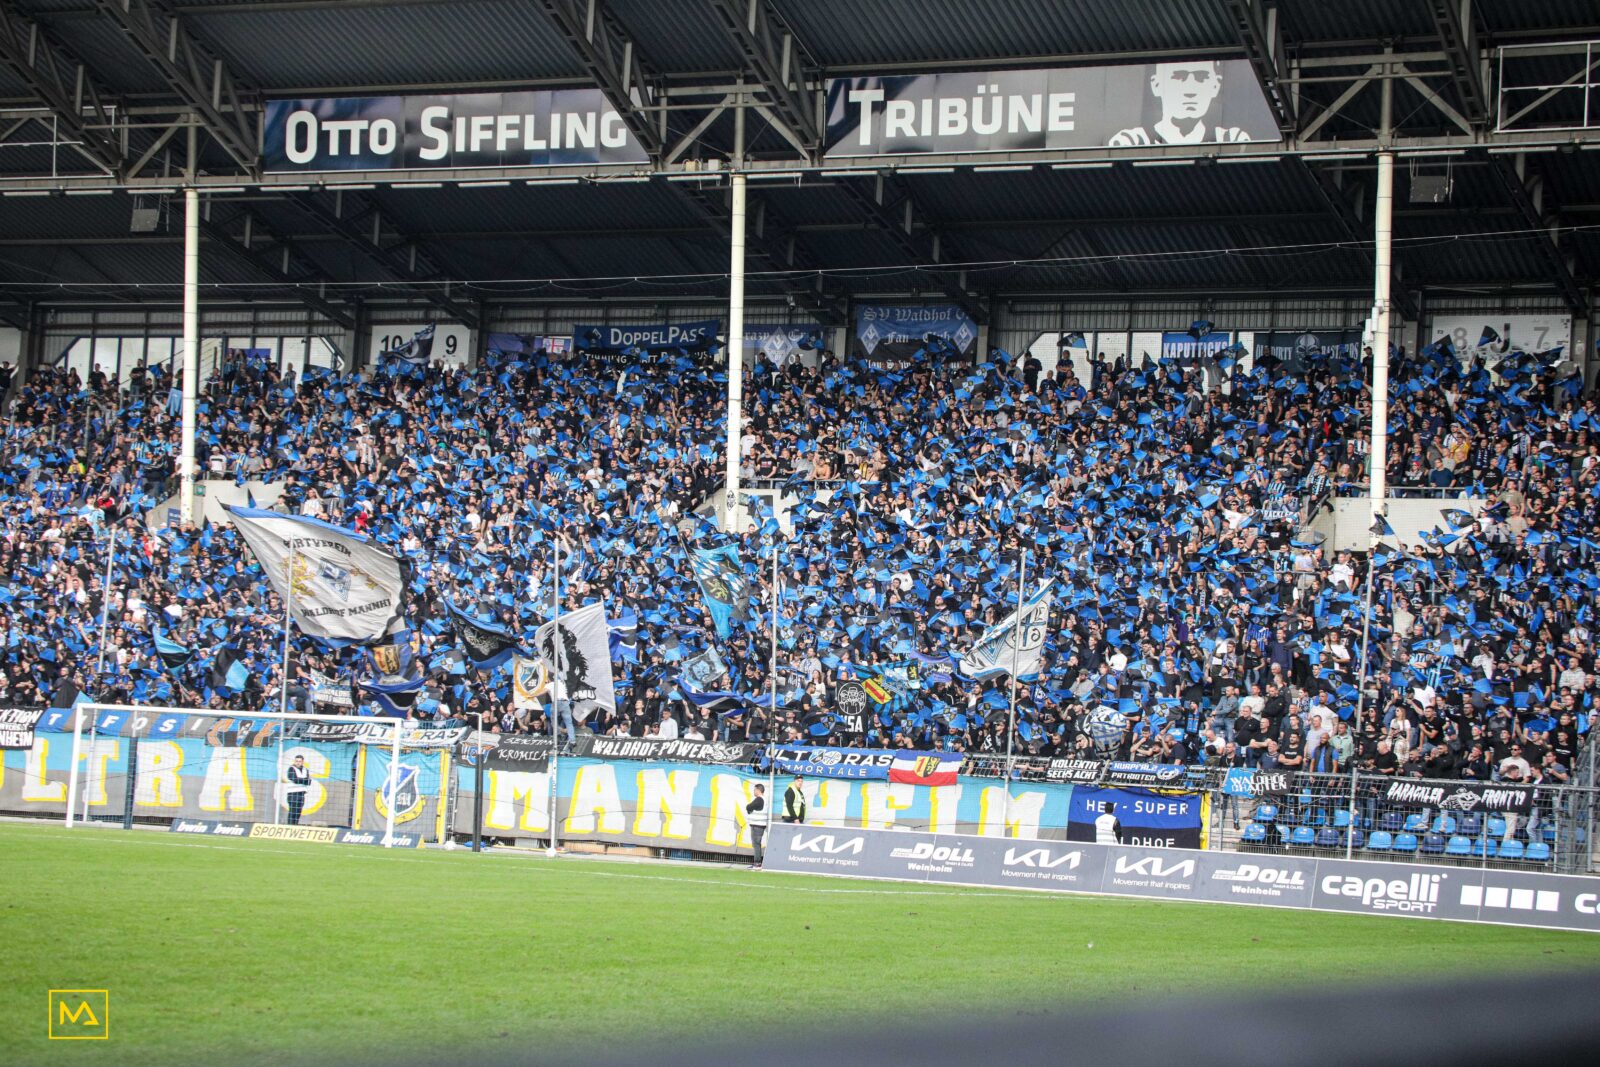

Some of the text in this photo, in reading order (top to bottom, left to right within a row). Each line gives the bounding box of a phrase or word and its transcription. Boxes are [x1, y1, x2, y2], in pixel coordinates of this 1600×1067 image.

[848, 84, 1075, 146] TRIBÜNE
[445, 334, 458, 355] 9
[1453, 327, 1468, 351] 8
[1533, 326, 1550, 349] 7
[0, 737, 331, 816] LTRAS
[1134, 800, 1189, 815] SUPER
[176, 820, 208, 834] bwin
[213, 822, 245, 836] bwin
[252, 825, 335, 842] SPORTWETTEN
[342, 831, 374, 845] bwin
[1321, 872, 1441, 905] capelli
[1372, 898, 1437, 913] SPORT
